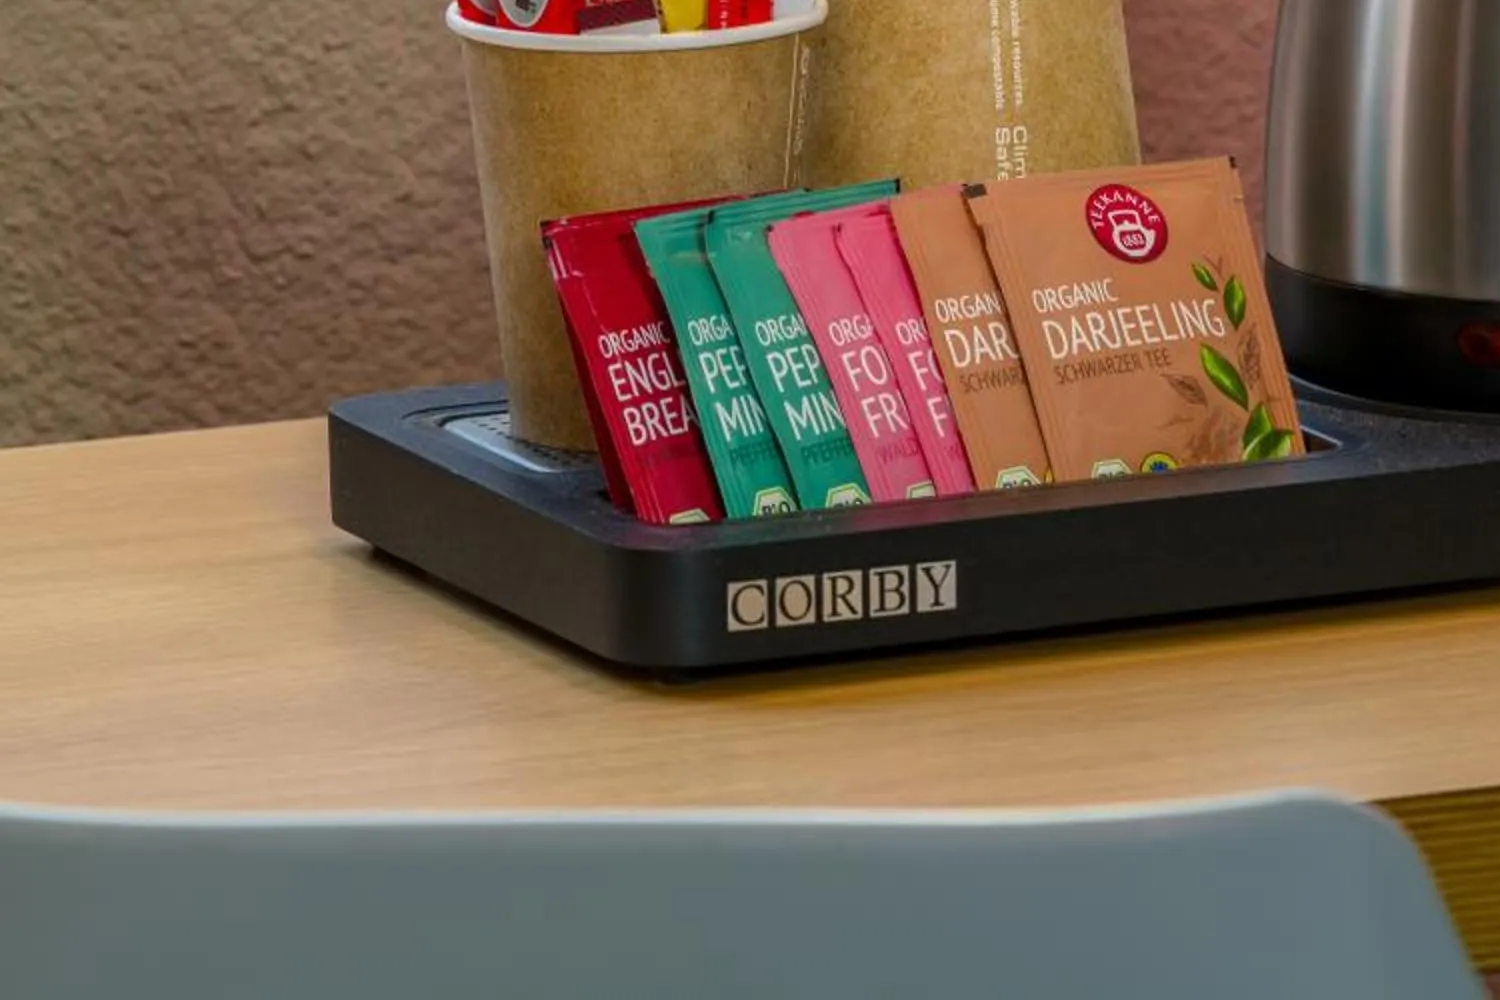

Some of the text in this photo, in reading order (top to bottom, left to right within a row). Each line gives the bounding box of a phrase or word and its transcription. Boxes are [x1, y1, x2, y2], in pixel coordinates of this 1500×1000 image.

[1090, 190, 1160, 230] TEEKANNE
[1032, 278, 1119, 314] ORGANIC
[598, 320, 671, 359] ORGANIC
[944, 321, 1020, 369] DAR
[1041, 299, 1226, 360] DARJEELING
[1053, 347, 1173, 385] SCHWARZER TEE
[730, 563, 953, 627] CORBY
